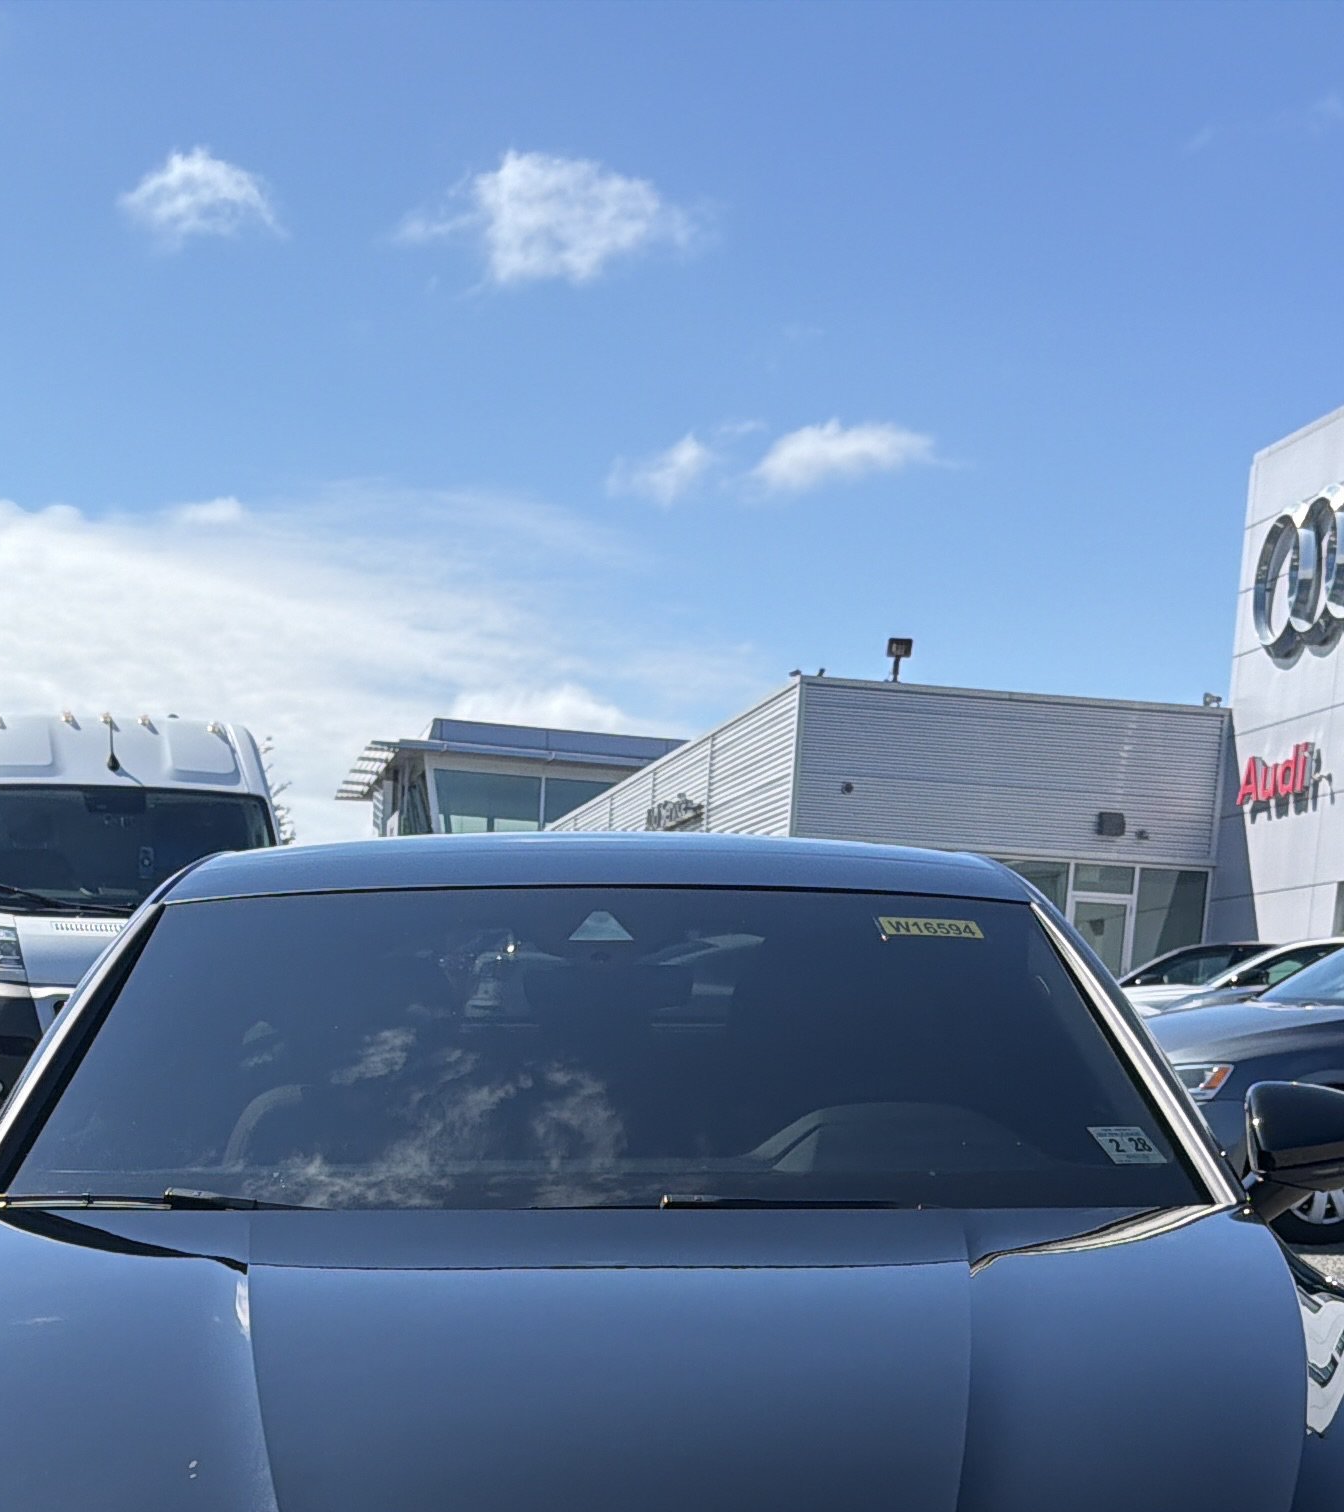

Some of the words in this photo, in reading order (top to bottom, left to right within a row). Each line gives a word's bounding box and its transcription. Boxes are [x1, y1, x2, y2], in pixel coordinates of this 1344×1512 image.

[1236, 742, 1312, 807] Audi
[886, 919, 977, 937] W16594
[1109, 1138, 1126, 1153] 2
[1128, 1137, 1153, 1153] 28
